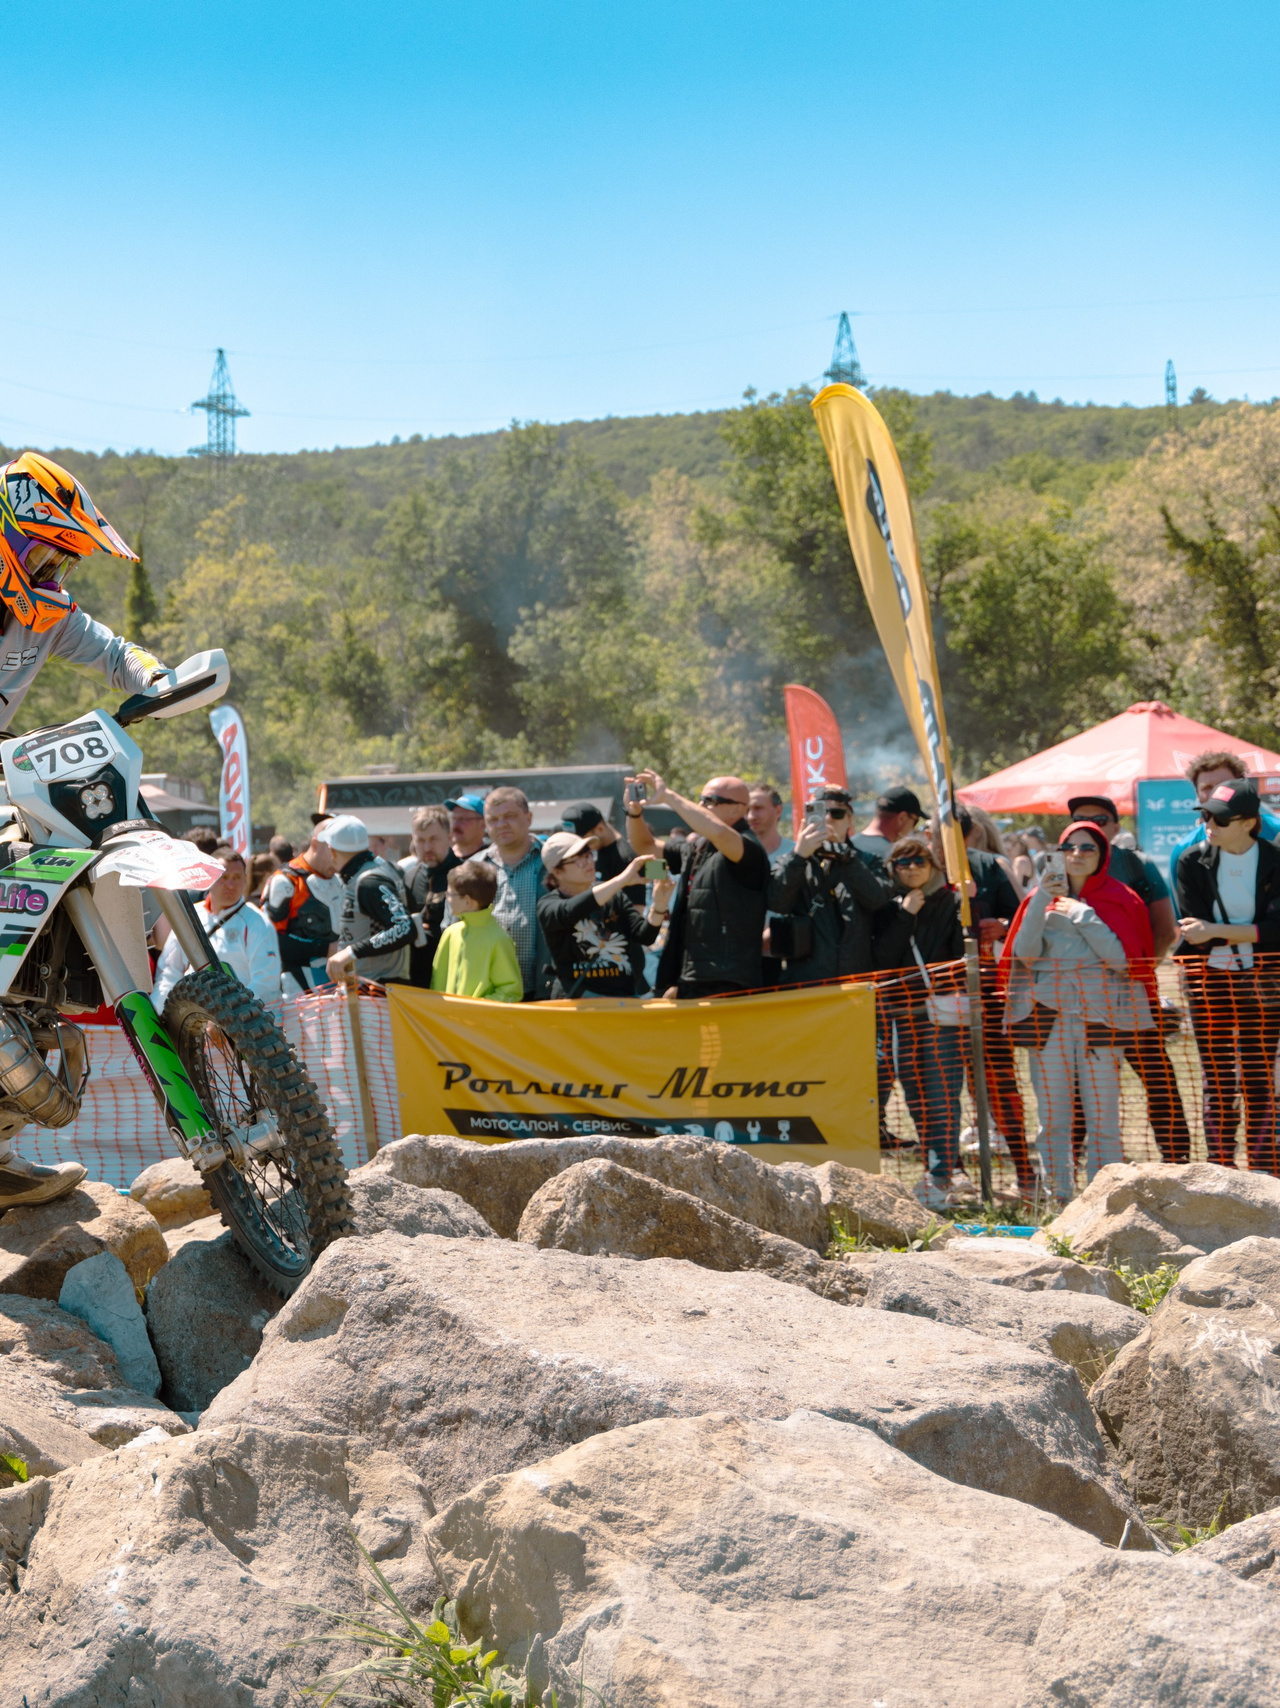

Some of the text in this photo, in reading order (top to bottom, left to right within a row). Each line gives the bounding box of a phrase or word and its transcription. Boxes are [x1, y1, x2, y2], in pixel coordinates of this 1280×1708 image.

[0, 646, 39, 671] 32
[34, 736, 109, 774] 708
[31, 855, 77, 868] KTM
[437, 1061, 827, 1099] Роллинг Мото
[470, 1116, 632, 1133] МОТОСАЛОН СЕРВИС
